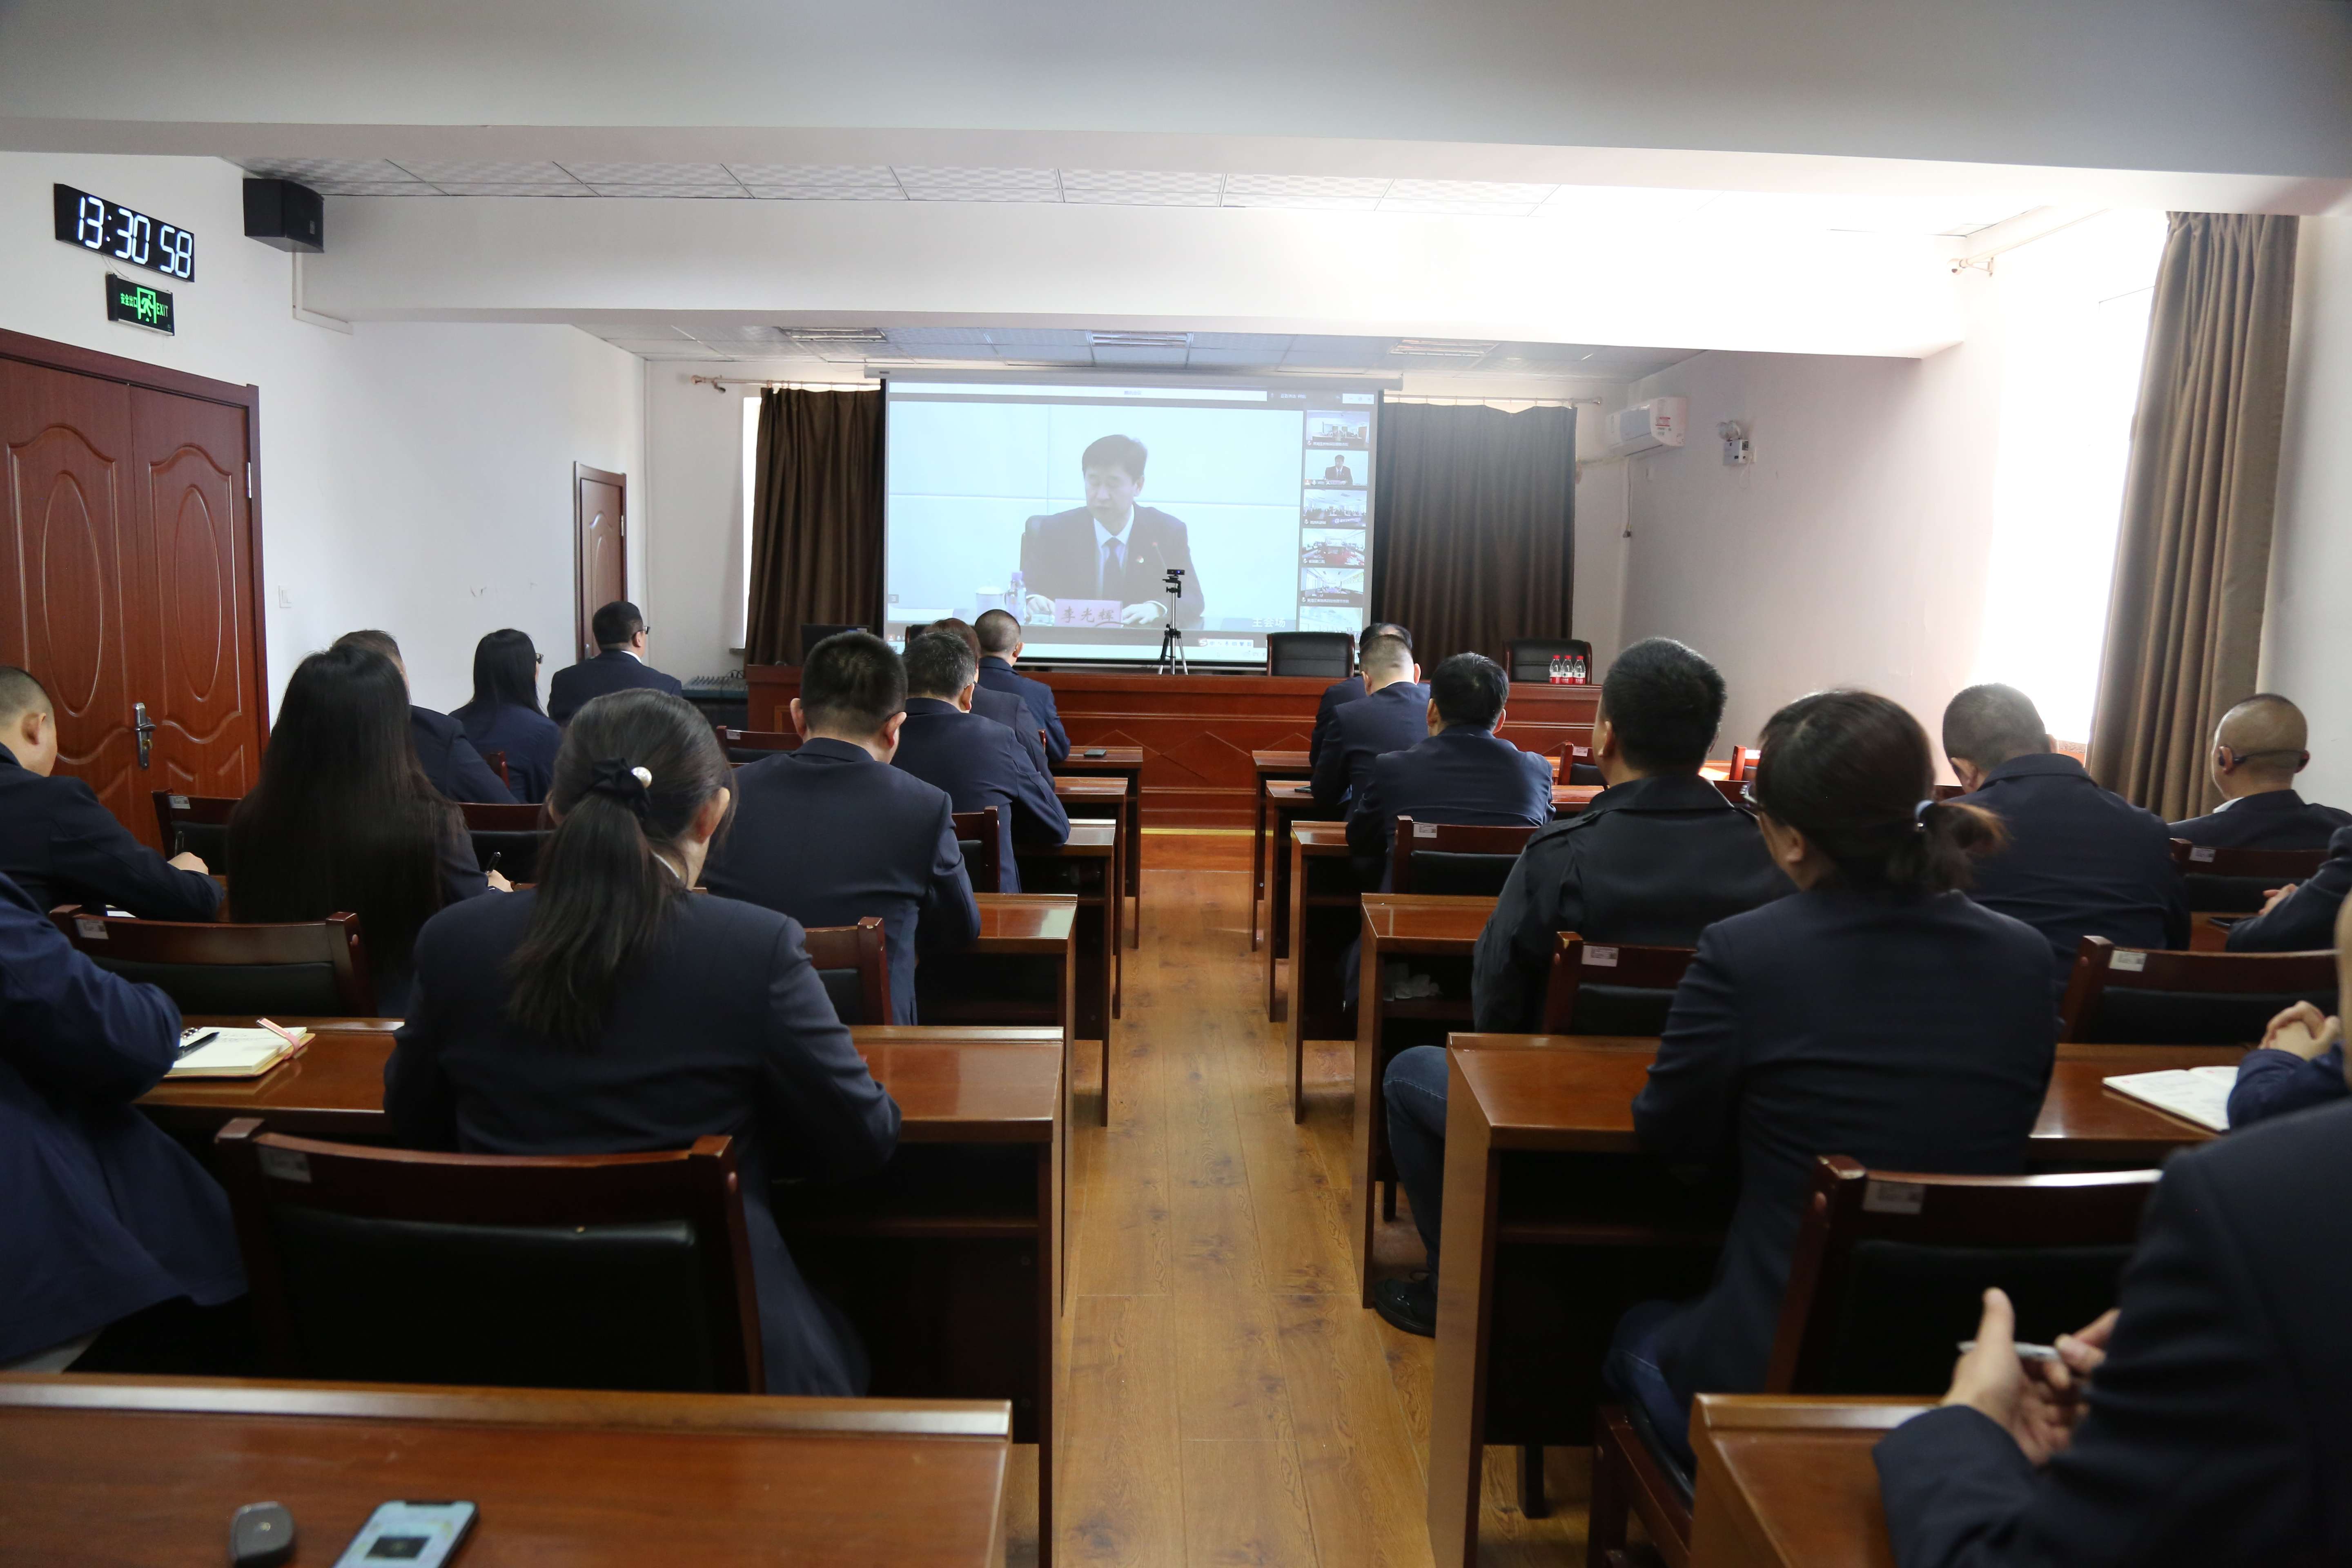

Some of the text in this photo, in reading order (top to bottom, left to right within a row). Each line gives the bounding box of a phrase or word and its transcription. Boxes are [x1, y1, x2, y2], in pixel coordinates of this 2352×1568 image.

[78, 196, 192, 278] 13:30 58
[120, 293, 137, 308] 安全出口
[157, 303, 168, 317] EXIT
[1061, 606, 1114, 623] 李光辉
[1252, 617, 1286, 628] 主会场
